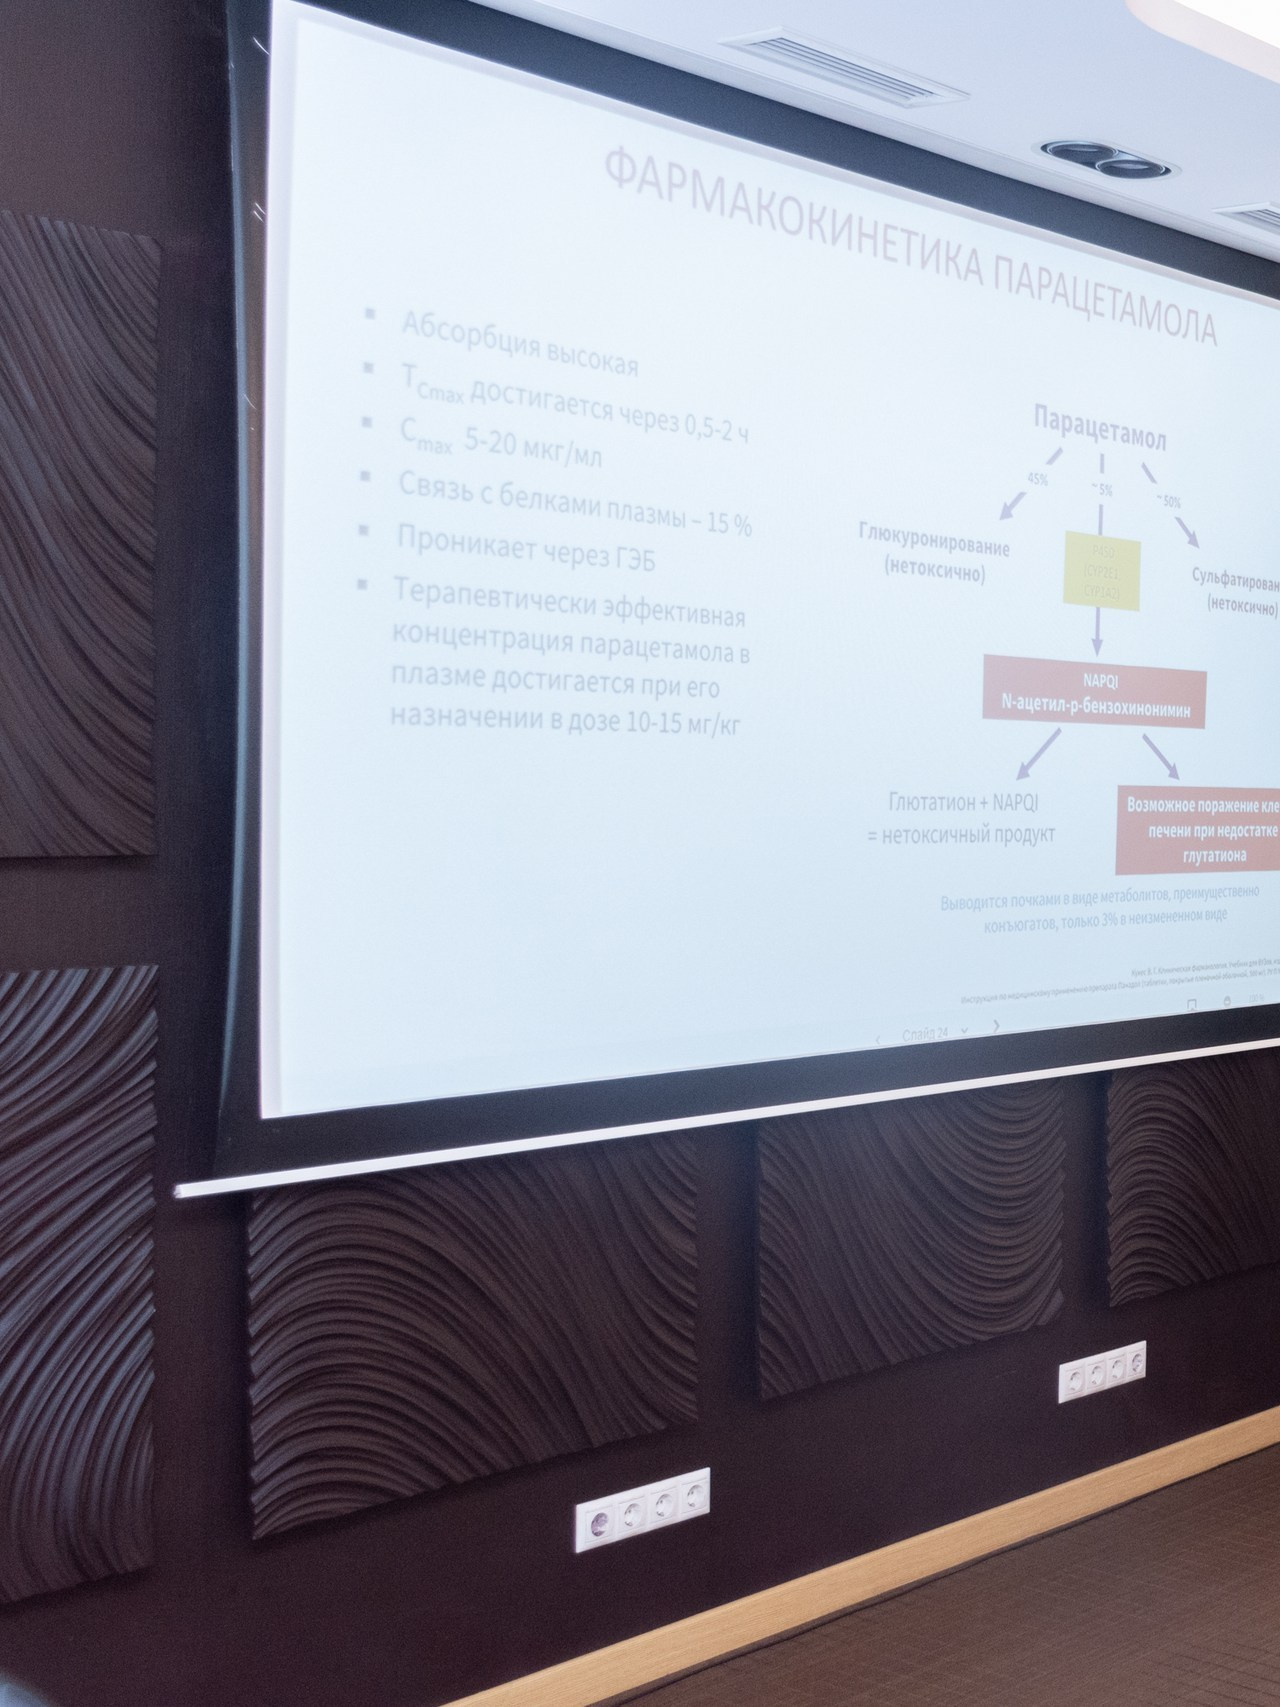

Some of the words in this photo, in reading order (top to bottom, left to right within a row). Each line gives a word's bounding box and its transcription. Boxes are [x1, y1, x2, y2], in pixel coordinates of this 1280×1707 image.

[605, 145, 984, 286] ФАРМАКОКИНЕТИКА
[993, 254, 1219, 347] ПАРАЦЕТАМОЛА
[403, 309, 541, 358] Абсорбция
[547, 341, 639, 377] высокая
[470, 379, 614, 421] достигается
[619, 403, 680, 433] через
[685, 412, 733, 441] 0,5-2
[738, 424, 750, 444] ч
[1034, 402, 1167, 453] Парацетамол
[464, 426, 517, 456] 5-20
[524, 439, 603, 469] мкг/мл
[1027, 471, 1049, 487] 45%
[399, 470, 474, 502] Связь
[480, 486, 494, 505] с
[499, 480, 602, 518] белками
[607, 498, 687, 529] плазмы
[707, 511, 730, 534] 15
[734, 513, 753, 538] %
[398, 523, 538, 562] Проникает
[543, 542, 611, 570] через
[616, 545, 657, 573] ГЭБ
[858, 520, 1011, 558] Глюкуронирование
[884, 553, 986, 586] (нетоксично)
[394, 575, 598, 617] Терапевтически
[603, 594, 747, 629] эффективная
[1207, 592, 1279, 620] (нетоксично)
[393, 622, 574, 657] концентрация
[580, 634, 735, 664] парацетамола
[740, 646, 751, 664] в
[391, 663, 487, 688] плазме
[492, 668, 636, 695] достигается
[641, 677, 682, 702] при
[686, 678, 720, 699] его
[1083, 672, 1120, 690] NAPQI
[391, 704, 544, 731] назначении
[550, 711, 563, 730] в
[568, 711, 621, 736] дозе
[626, 710, 683, 735] 10-15
[687, 711, 741, 739] мг/кг
[889, 790, 976, 813] Глютатион
[993, 792, 1039, 815] NAPQI
[1127, 796, 1196, 814] Возможное
[1198, 798, 1259, 817] поражение
[882, 822, 990, 846] нетоксичный
[994, 826, 1056, 849] продукт
[1148, 824, 1192, 839] печени
[1194, 825, 1215, 842] при
[1217, 823, 1279, 841] недостатке
[1183, 847, 1247, 866] глутатиона
[941, 894, 1008, 914] Выводится
[1010, 892, 1061, 911] почками
[1063, 893, 1070, 906] в
[1072, 890, 1099, 908] виде
[1101, 886, 1172, 906] метаболитов,
[1173, 883, 1260, 904] преимущественно
[984, 915, 1060, 936] конъюгатов,
[1061, 912, 1100, 931] только
[1101, 911, 1118, 928] 3%
[1120, 913, 1127, 926] в
[1128, 908, 1203, 927] неизмененном
[1205, 907, 1228, 924] виде
[902, 1026, 935, 1042] Слайд
[937, 1026, 948, 1039] 24
